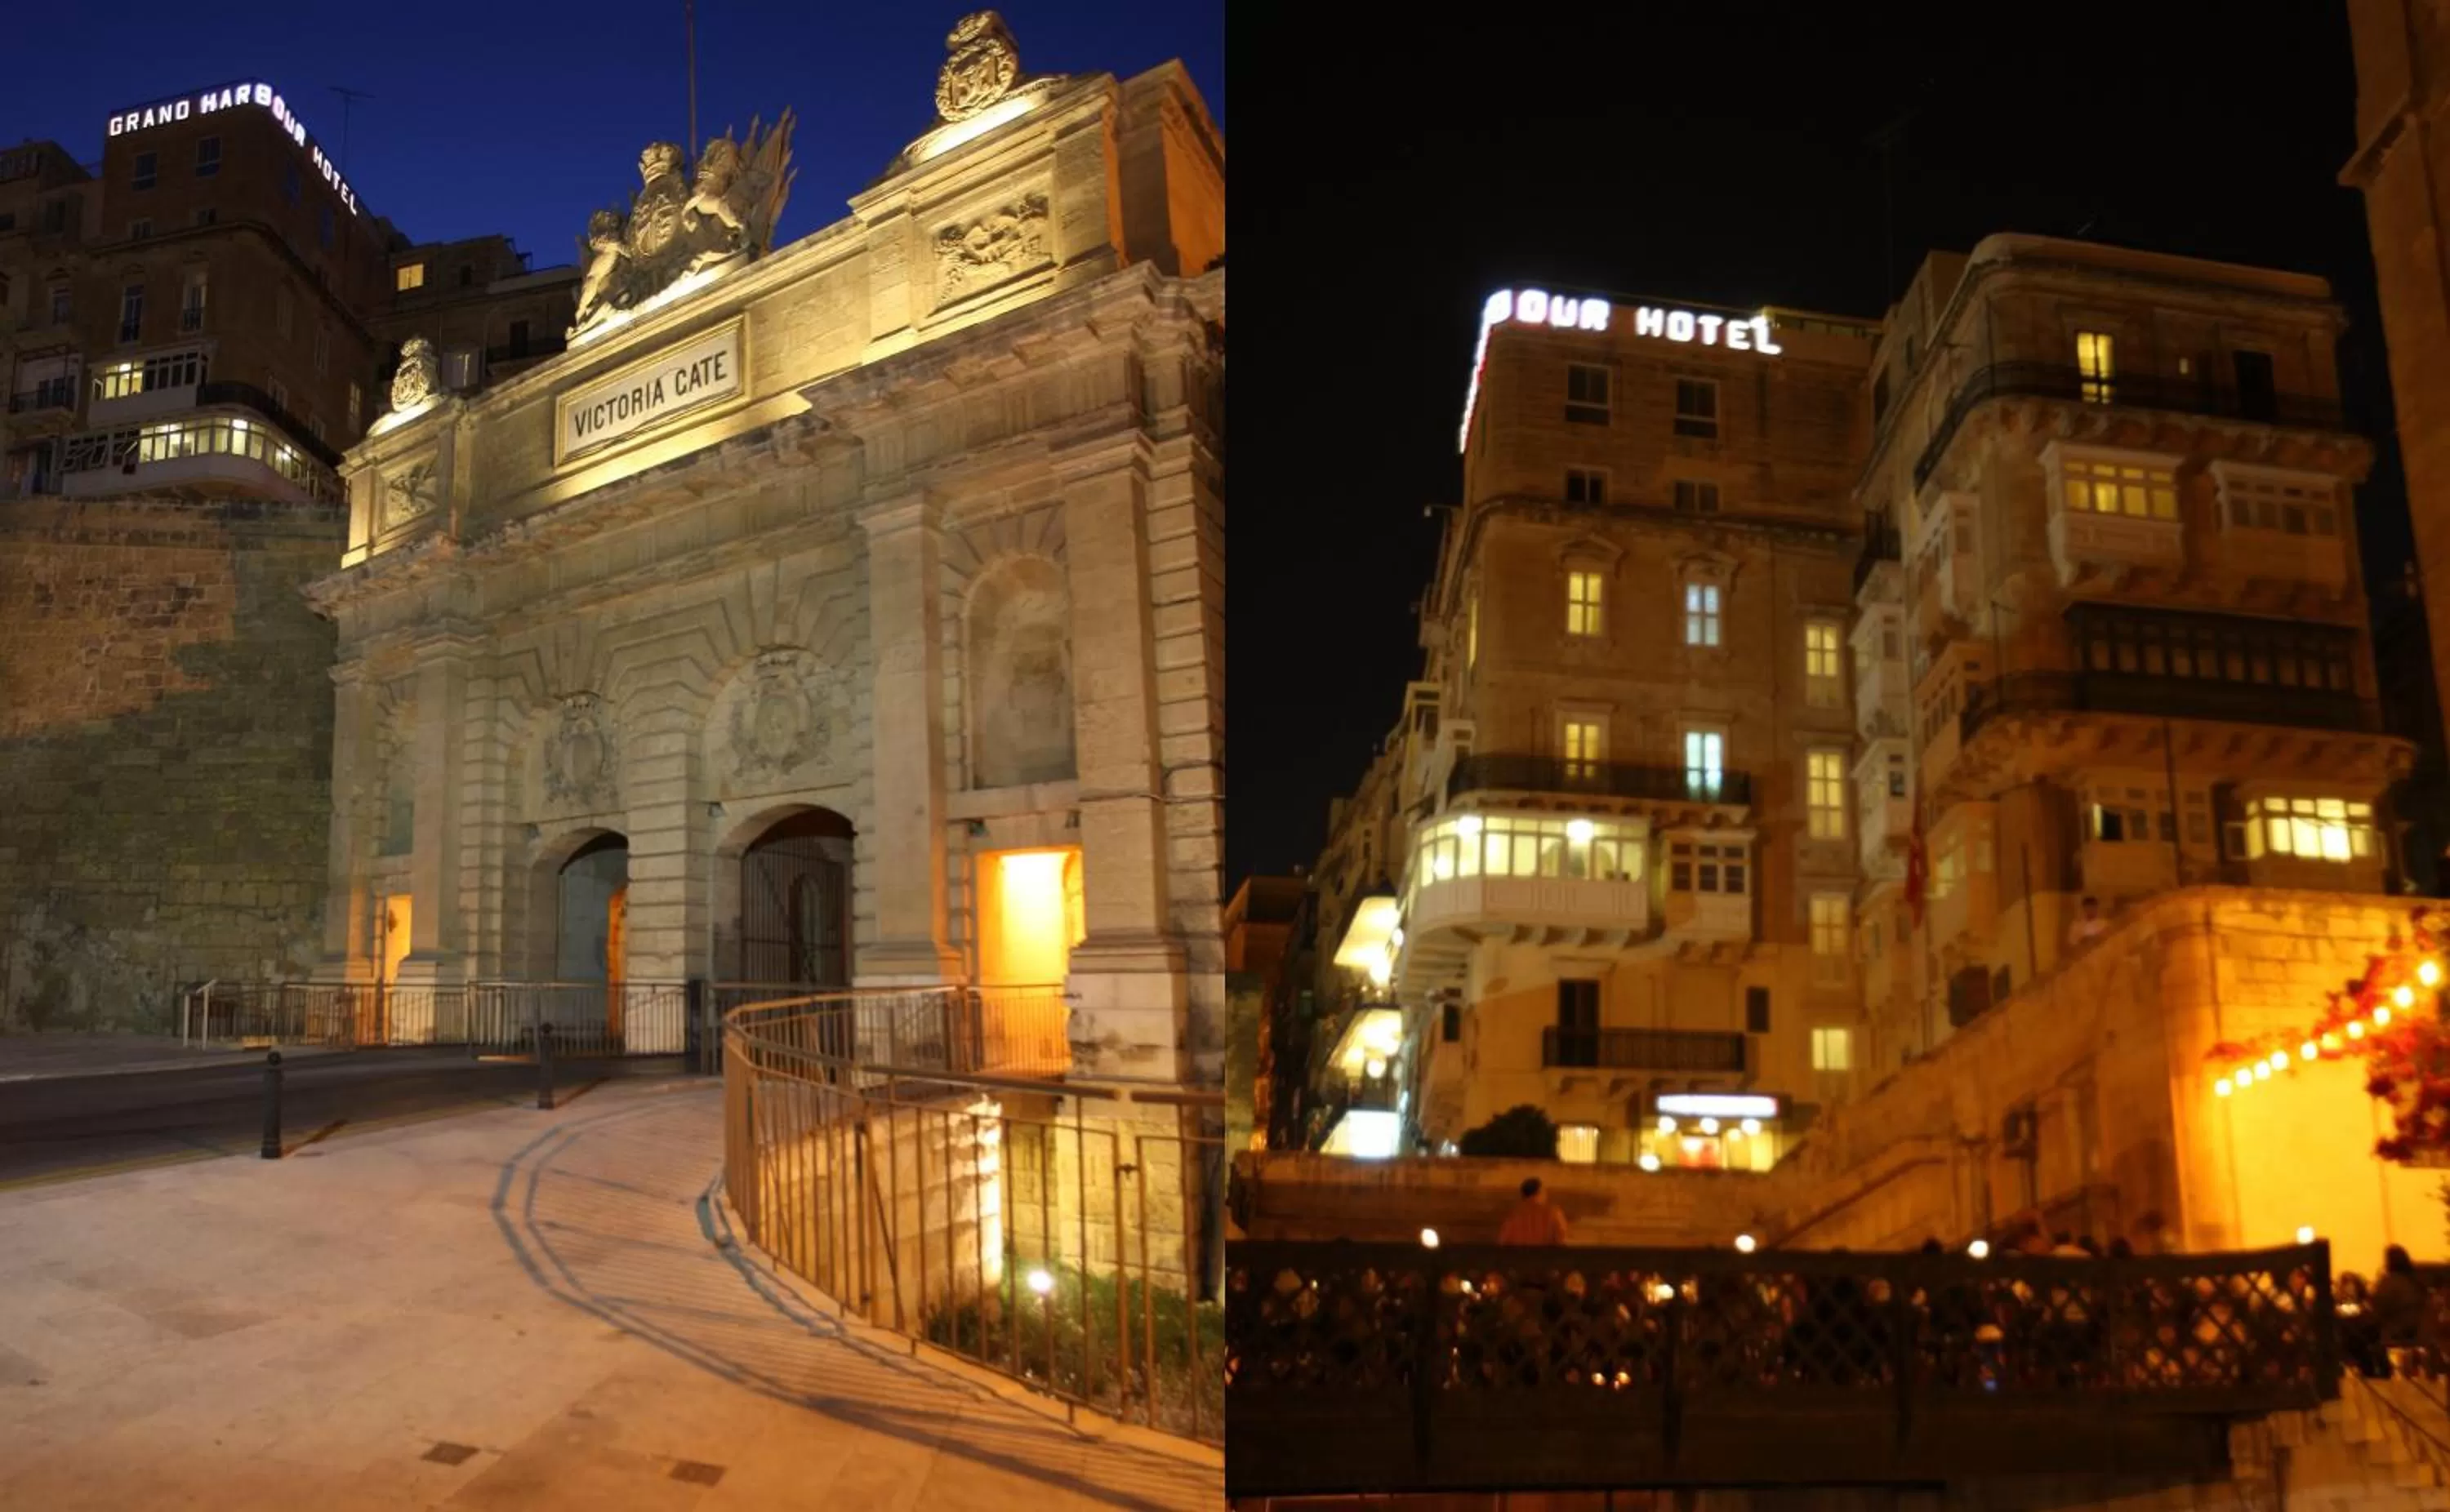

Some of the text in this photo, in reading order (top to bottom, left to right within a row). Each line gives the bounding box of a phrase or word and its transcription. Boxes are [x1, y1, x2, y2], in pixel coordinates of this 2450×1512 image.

[109, 83, 357, 216] GRAND HARBOUR HOTEL
[1635, 307, 1782, 355] HOTEL
[574, 378, 664, 437] VICTORIA
